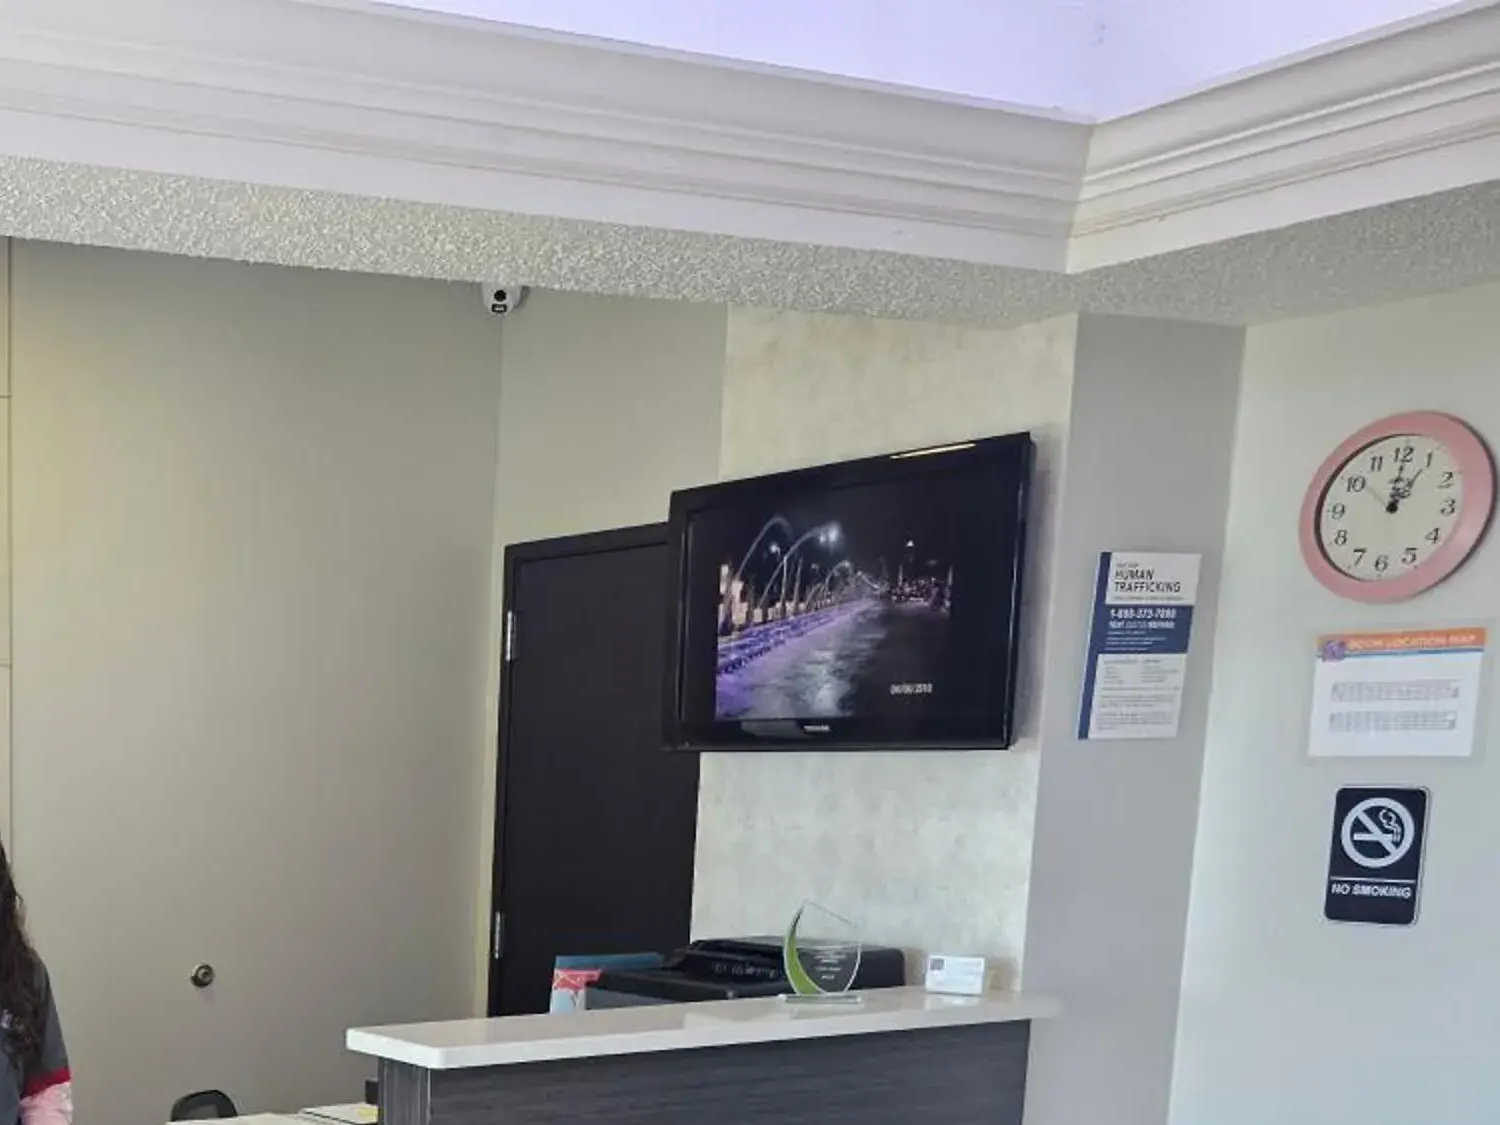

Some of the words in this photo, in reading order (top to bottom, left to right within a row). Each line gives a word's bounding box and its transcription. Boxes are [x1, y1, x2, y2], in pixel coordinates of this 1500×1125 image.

[1393, 446, 1414, 463] 12
[1425, 450, 1433, 468] 1
[1370, 456, 1383, 472] 11
[1346, 475, 1366, 492] 10
[1437, 471, 1454, 489] 2
[1331, 502, 1346, 520] 9
[1440, 499, 1456, 516] 3
[1334, 530, 1347, 546] 8
[1425, 527, 1440, 544] 4
[1353, 548, 1367, 567] 7
[1374, 554, 1389, 572] 6
[1401, 547, 1418, 565] 5
[1114, 568, 1155, 580] HUMAN
[1113, 581, 1181, 593] TRAFFICKING
[1331, 882, 1350, 895] NO
[1352, 883, 1411, 899] SMOKING
